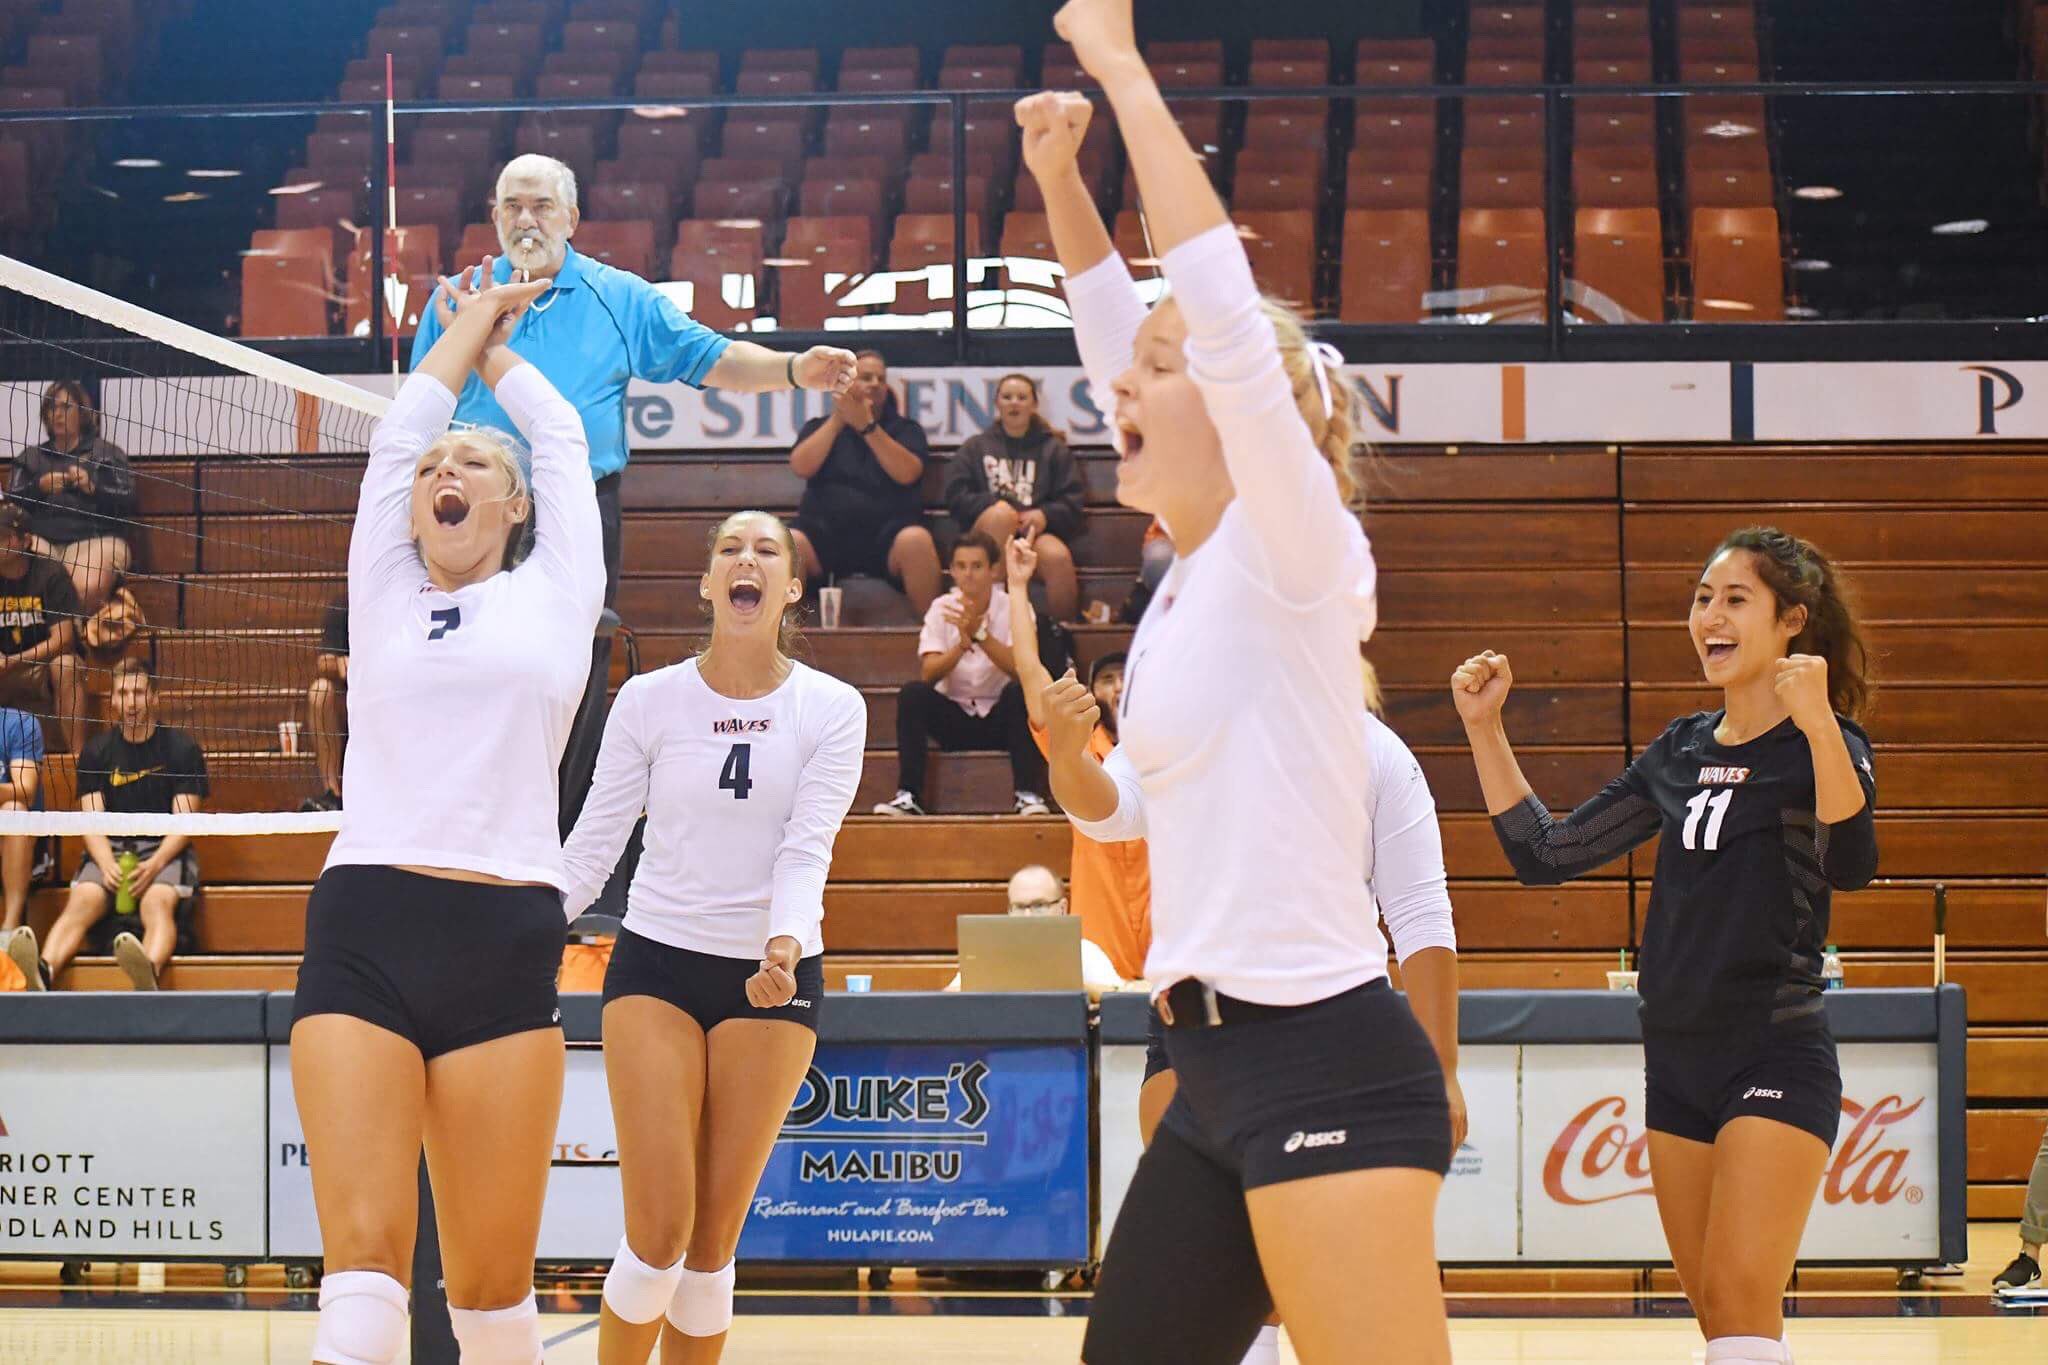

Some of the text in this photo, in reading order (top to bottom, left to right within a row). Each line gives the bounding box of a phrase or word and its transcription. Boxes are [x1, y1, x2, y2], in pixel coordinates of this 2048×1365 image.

[428, 606, 461, 640] 7
[713, 718, 771, 734] WAVES
[719, 743, 752, 799] 4
[1697, 766, 1751, 784] WAVES
[1682, 789, 1734, 850] 11
[800, 1150, 961, 1183] MALIBU
[74, 1187, 196, 1207] CENTER
[753, 1196, 1009, 1226] Restaurant and Barefoot Bar
[0, 1218, 223, 1240] DLAND HILLS
[827, 1229, 934, 1242] HULAPIE.COM
